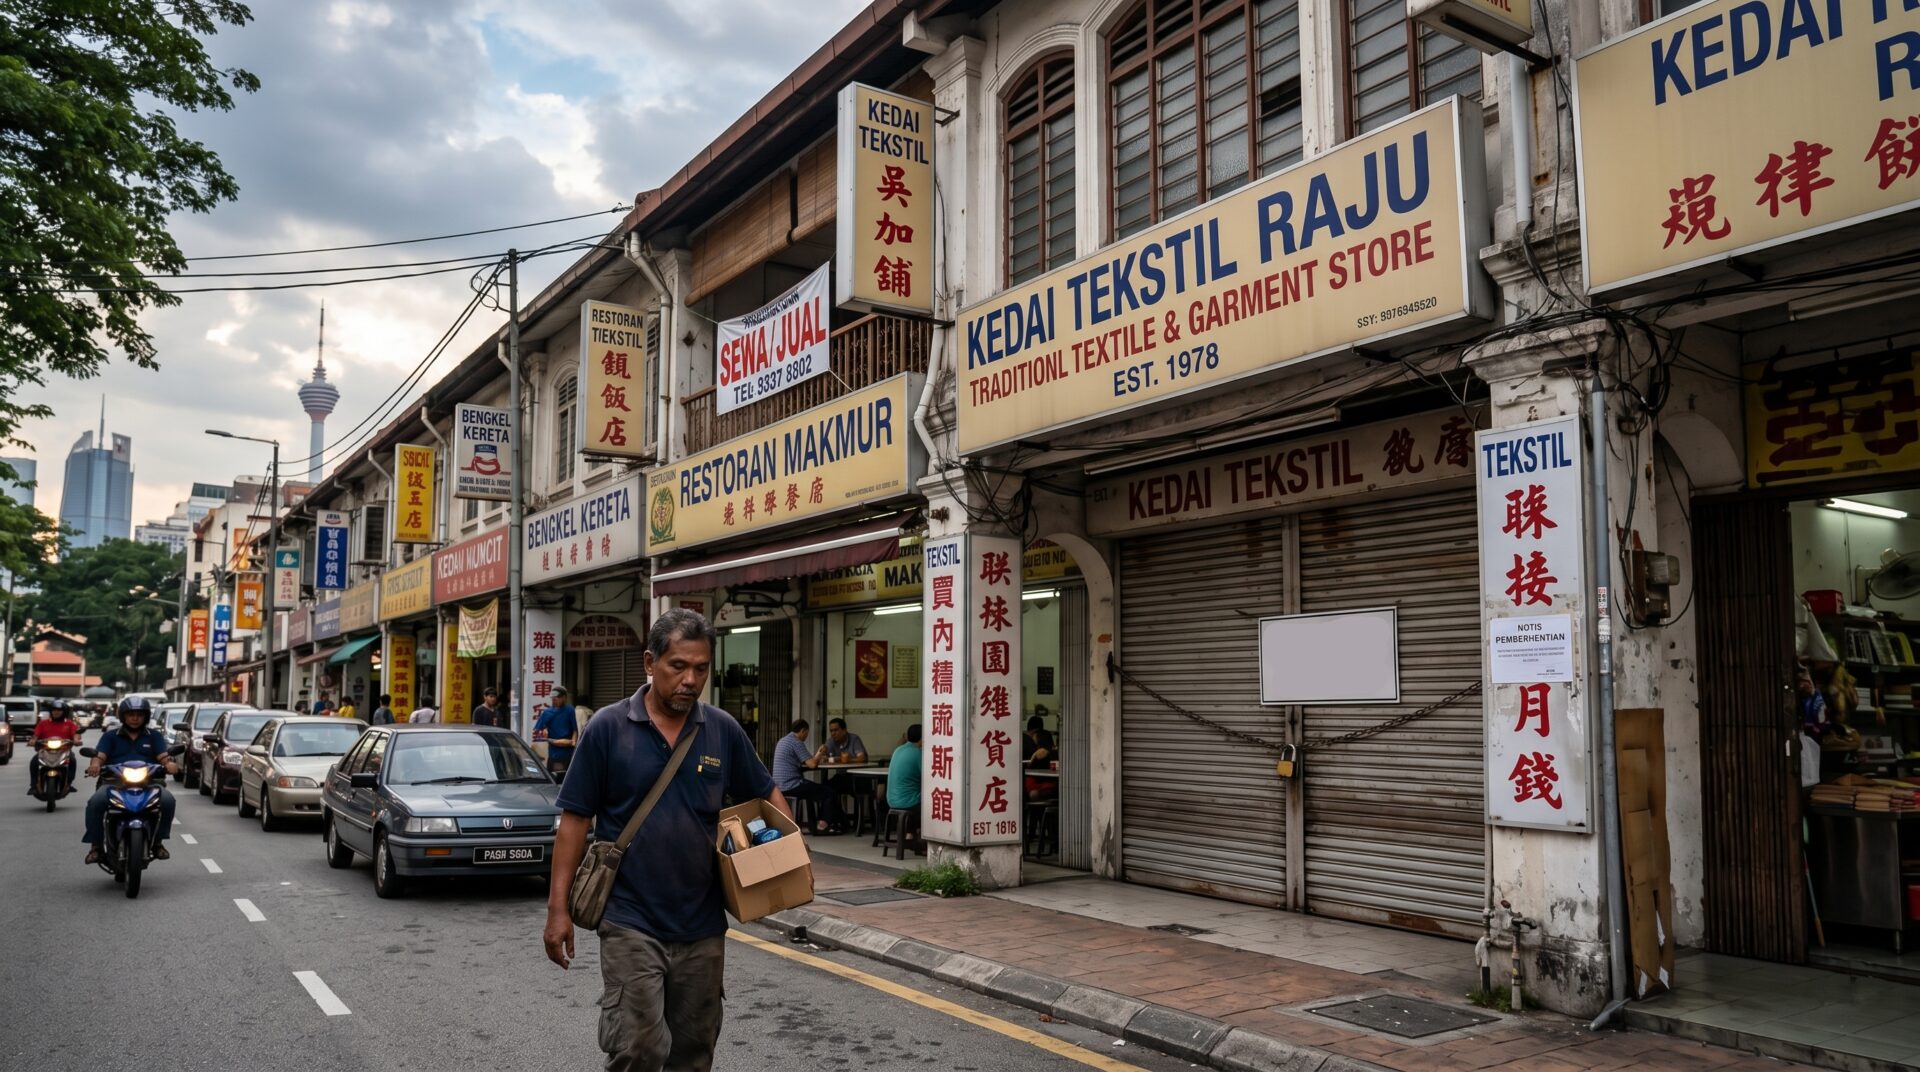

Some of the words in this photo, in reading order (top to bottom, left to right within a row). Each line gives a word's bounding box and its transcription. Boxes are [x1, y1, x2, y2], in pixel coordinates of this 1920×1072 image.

[868, 98, 919, 134] KEDAI
[859, 125, 929, 165] TEKSTIL
[967, 287, 1055, 370] KEDAI
[1067, 217, 1238, 332] TEKSTIL
[1258, 130, 1430, 264] RAJU
[592, 308, 643, 329] RESTORAN
[969, 350, 1068, 406] TRADITIONL
[1072, 316, 1157, 372] TEXTILE
[1164, 316, 1181, 344] &
[1188, 260, 1319, 336] GARMENT
[1329, 220, 1435, 291] STORE
[1357, 314, 1378, 328] SSY:
[720, 296, 826, 387] SEWA/JUAL
[786, 354, 812, 383] 8802
[1114, 367, 1158, 398] EST.
[1167, 342, 1219, 380] 1978
[462, 409, 511, 427] BENGKEL
[463, 426, 509, 443] KERETA
[680, 438, 776, 508] RESTORAN
[784, 397, 892, 476] MAKMUR
[1483, 431, 1572, 478] TEKSTIL
[1128, 467, 1212, 520] KEDAI
[1224, 439, 1364, 504] TEKSTIL
[528, 507, 577, 550] BENGKEL
[581, 487, 630, 533] KERETA
[927, 543, 960, 568] TEKSTIL
[1496, 633, 1565, 644] PEMBERHENTIAN
[1517, 623, 1542, 632] NOTIS
[973, 822, 991, 835] EST
